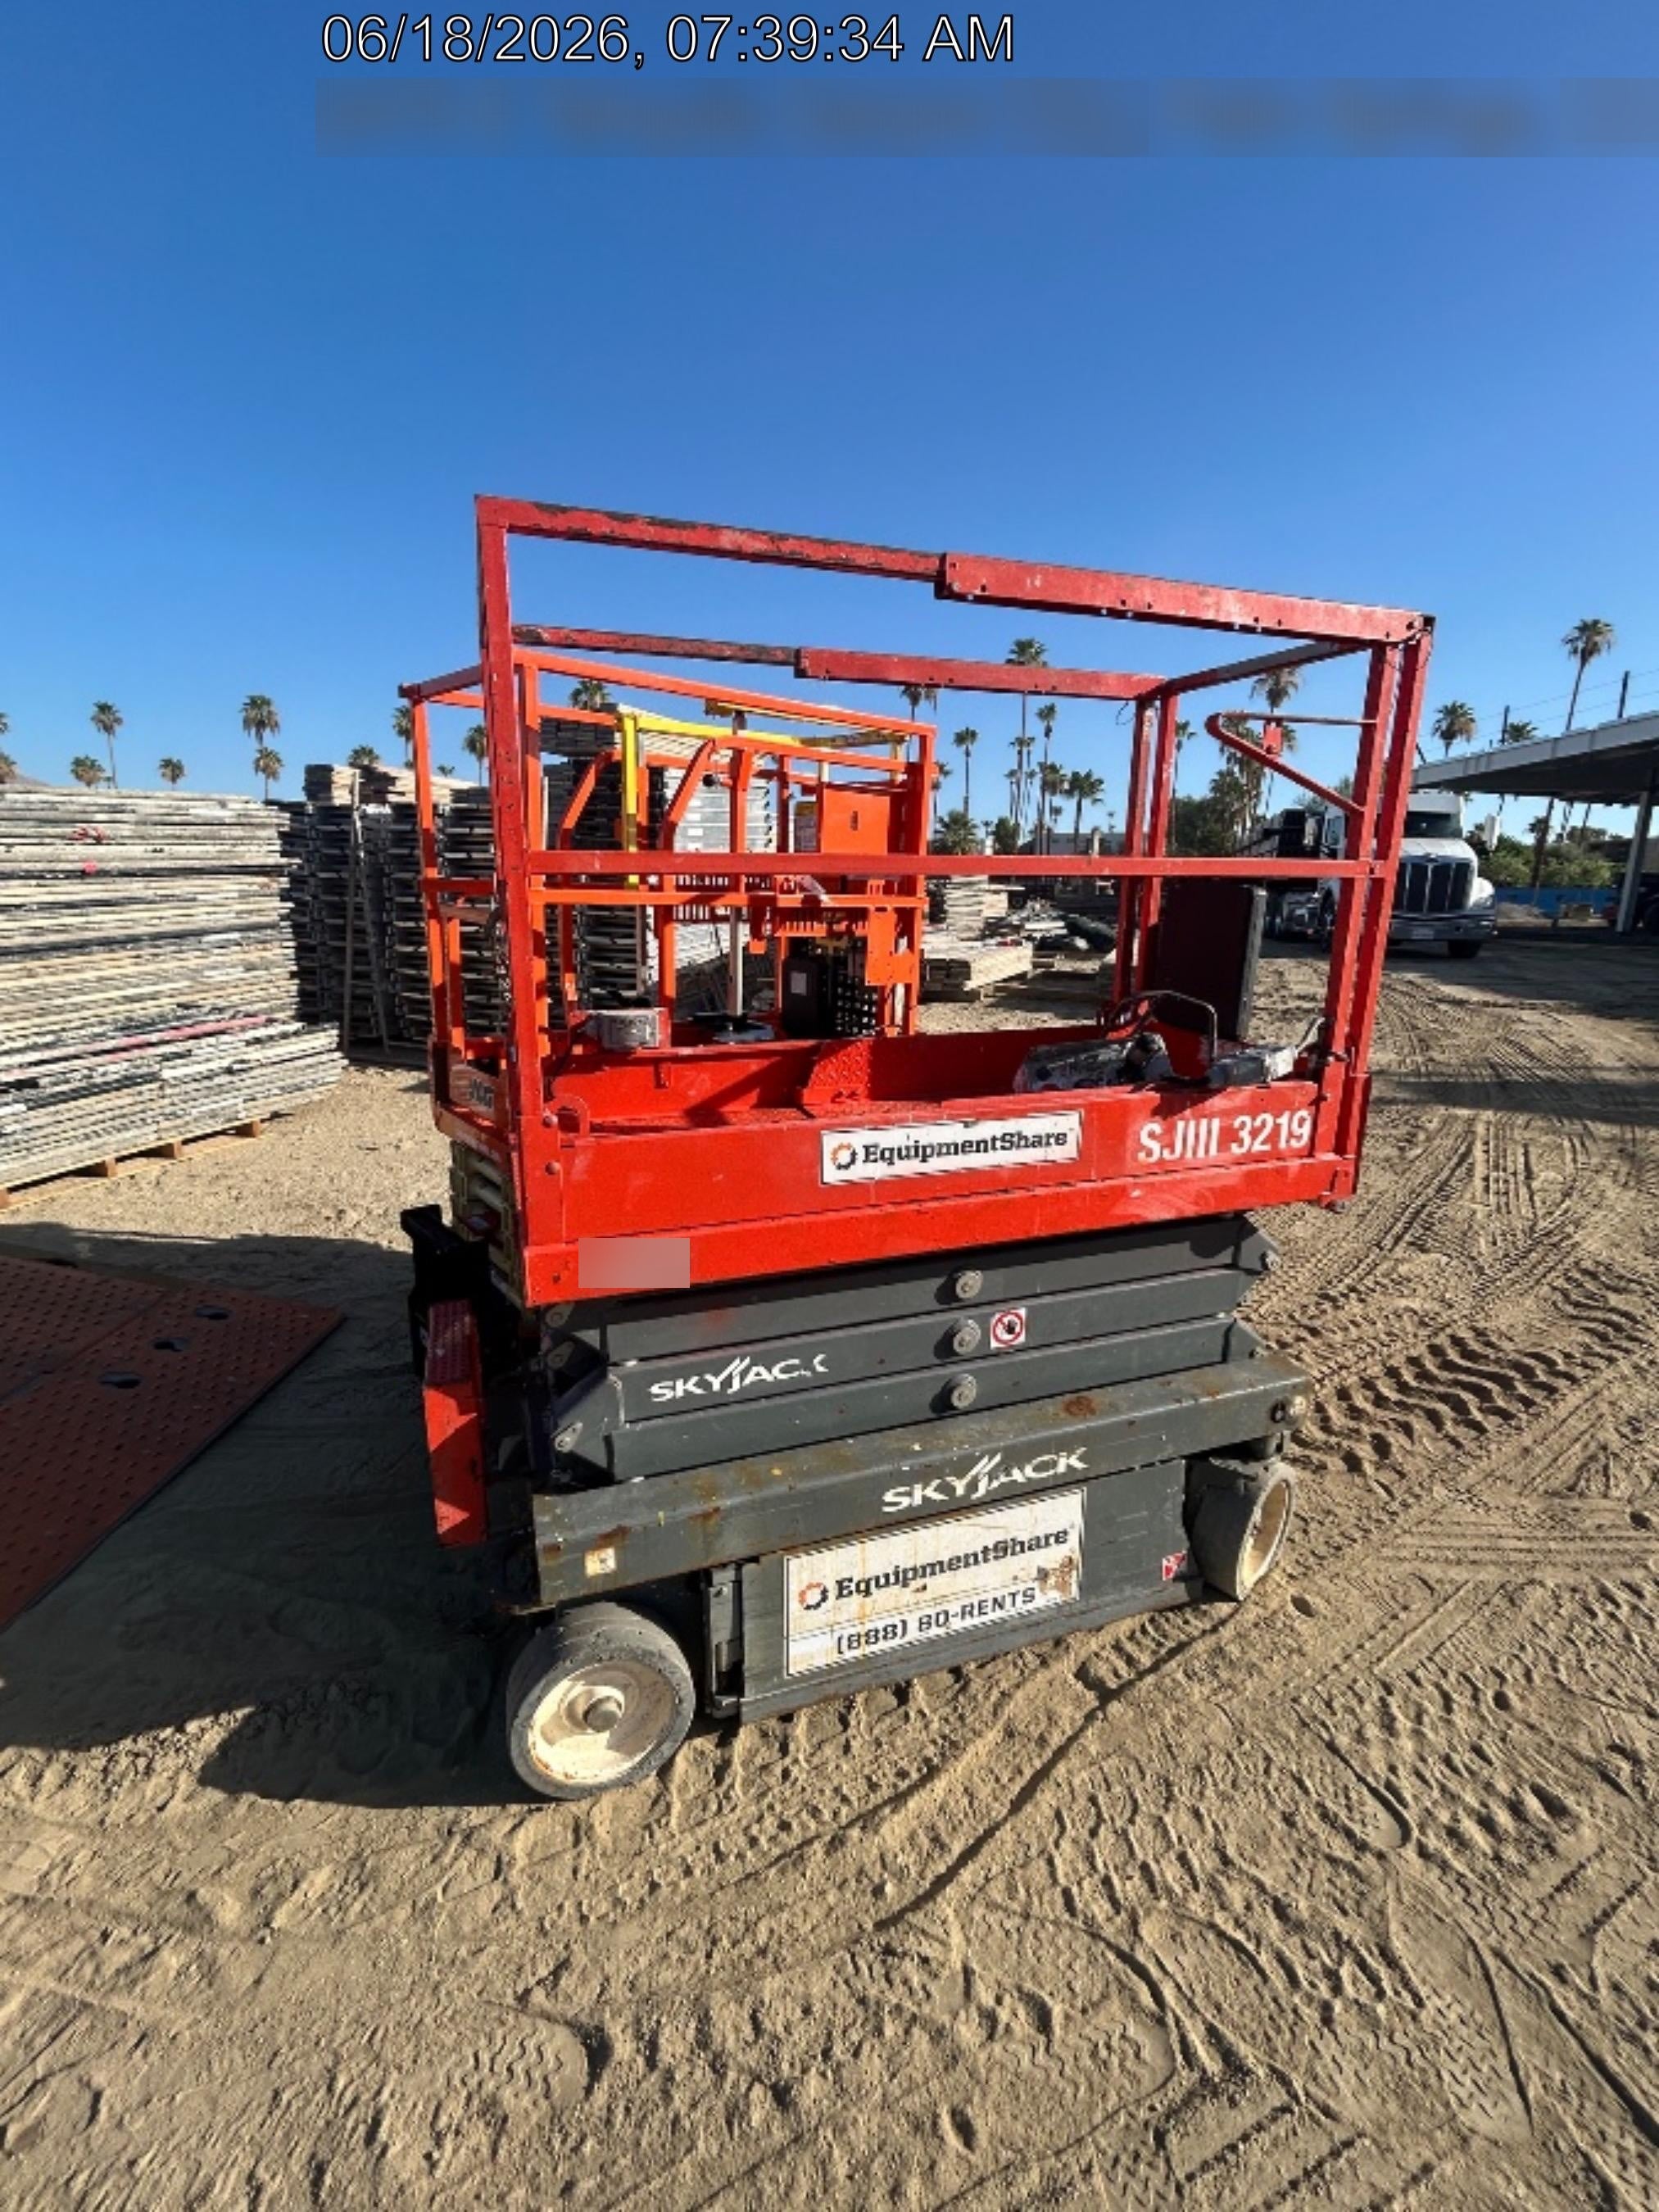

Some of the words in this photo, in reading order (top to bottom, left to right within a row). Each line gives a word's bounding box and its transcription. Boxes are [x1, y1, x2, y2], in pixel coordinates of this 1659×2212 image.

[862, 1131, 1067, 1166] EquipmentShare
[1231, 1109, 1312, 1155] 3219
[882, 1447, 1090, 1513] SKYJACK
[835, 1528, 1070, 1600] EquipmentShare
[836, 1618, 908, 1655] (888)
